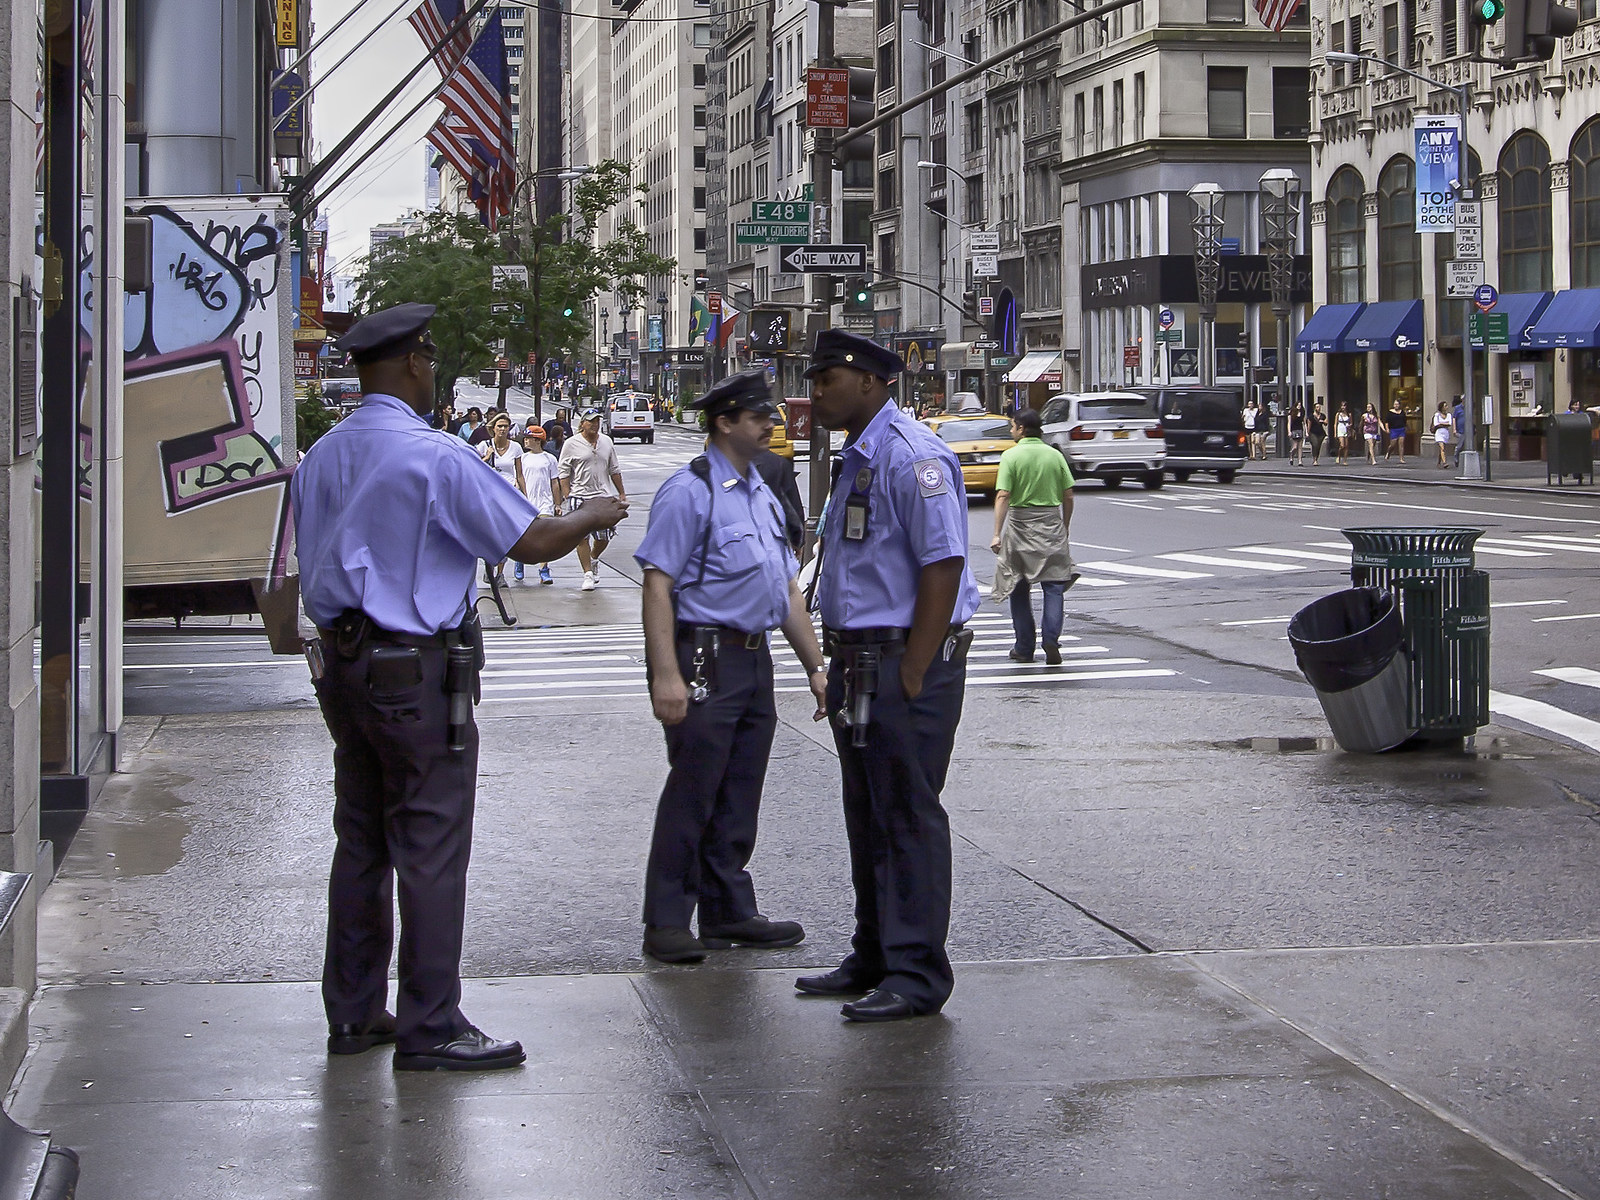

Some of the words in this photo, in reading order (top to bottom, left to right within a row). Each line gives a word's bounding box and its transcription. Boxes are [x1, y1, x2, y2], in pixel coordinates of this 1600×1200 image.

[809, 72, 826, 81] SNOW
[829, 73, 847, 82] ROUTE
[809, 94, 817, 103] NO
[820, 95, 847, 104] STANDING
[1419, 145, 1442, 153] POINT
[1419, 153, 1454, 164] VIEW
[1420, 192, 1454, 205] TOP
[756, 204, 767, 220] E
[771, 204, 795, 220] 48
[797, 204, 807, 213] ST
[1421, 206, 1434, 214] OF
[1435, 206, 1454, 214] THE
[1460, 204, 1475, 214] BUS
[1421, 214, 1454, 225] ROCK
[1459, 216, 1478, 225] LANE
[737, 225, 767, 237] WILLIAM
[770, 226, 808, 237] GOLDBERG
[793, 253, 818, 265] ONE
[829, 253, 856, 265] WAY
[1452, 263, 1478, 271] BUSES
[1216, 265, 1313, 292] JEWERS
[1455, 275, 1475, 283] ONLY
[684, 353, 704, 362] LENS
[1460, 615, 1477, 623] Fifth
